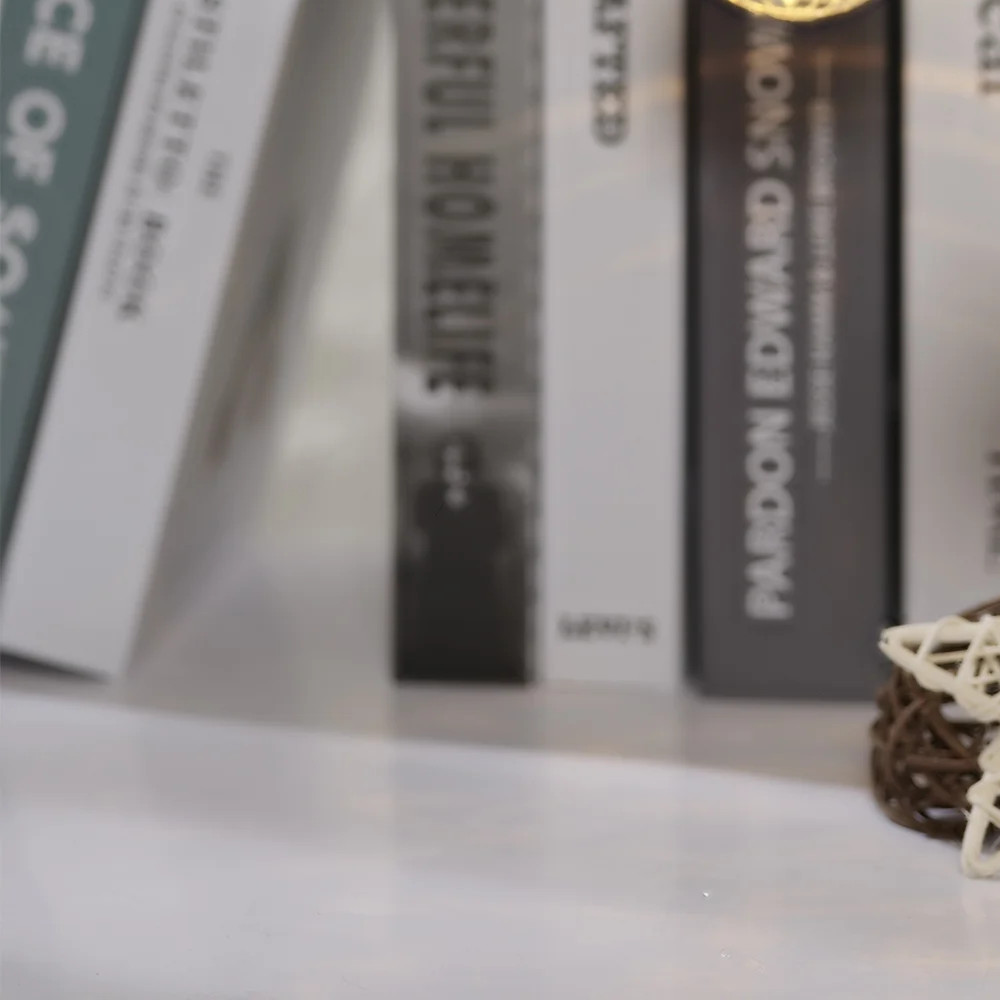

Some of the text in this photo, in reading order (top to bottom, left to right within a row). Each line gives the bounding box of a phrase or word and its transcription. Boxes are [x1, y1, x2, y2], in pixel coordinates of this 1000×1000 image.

[4, 88, 66, 186] OF
[421, 155, 495, 393] HOMELIFE
[744, 20, 795, 621] PARDON EDWARD SNOW
